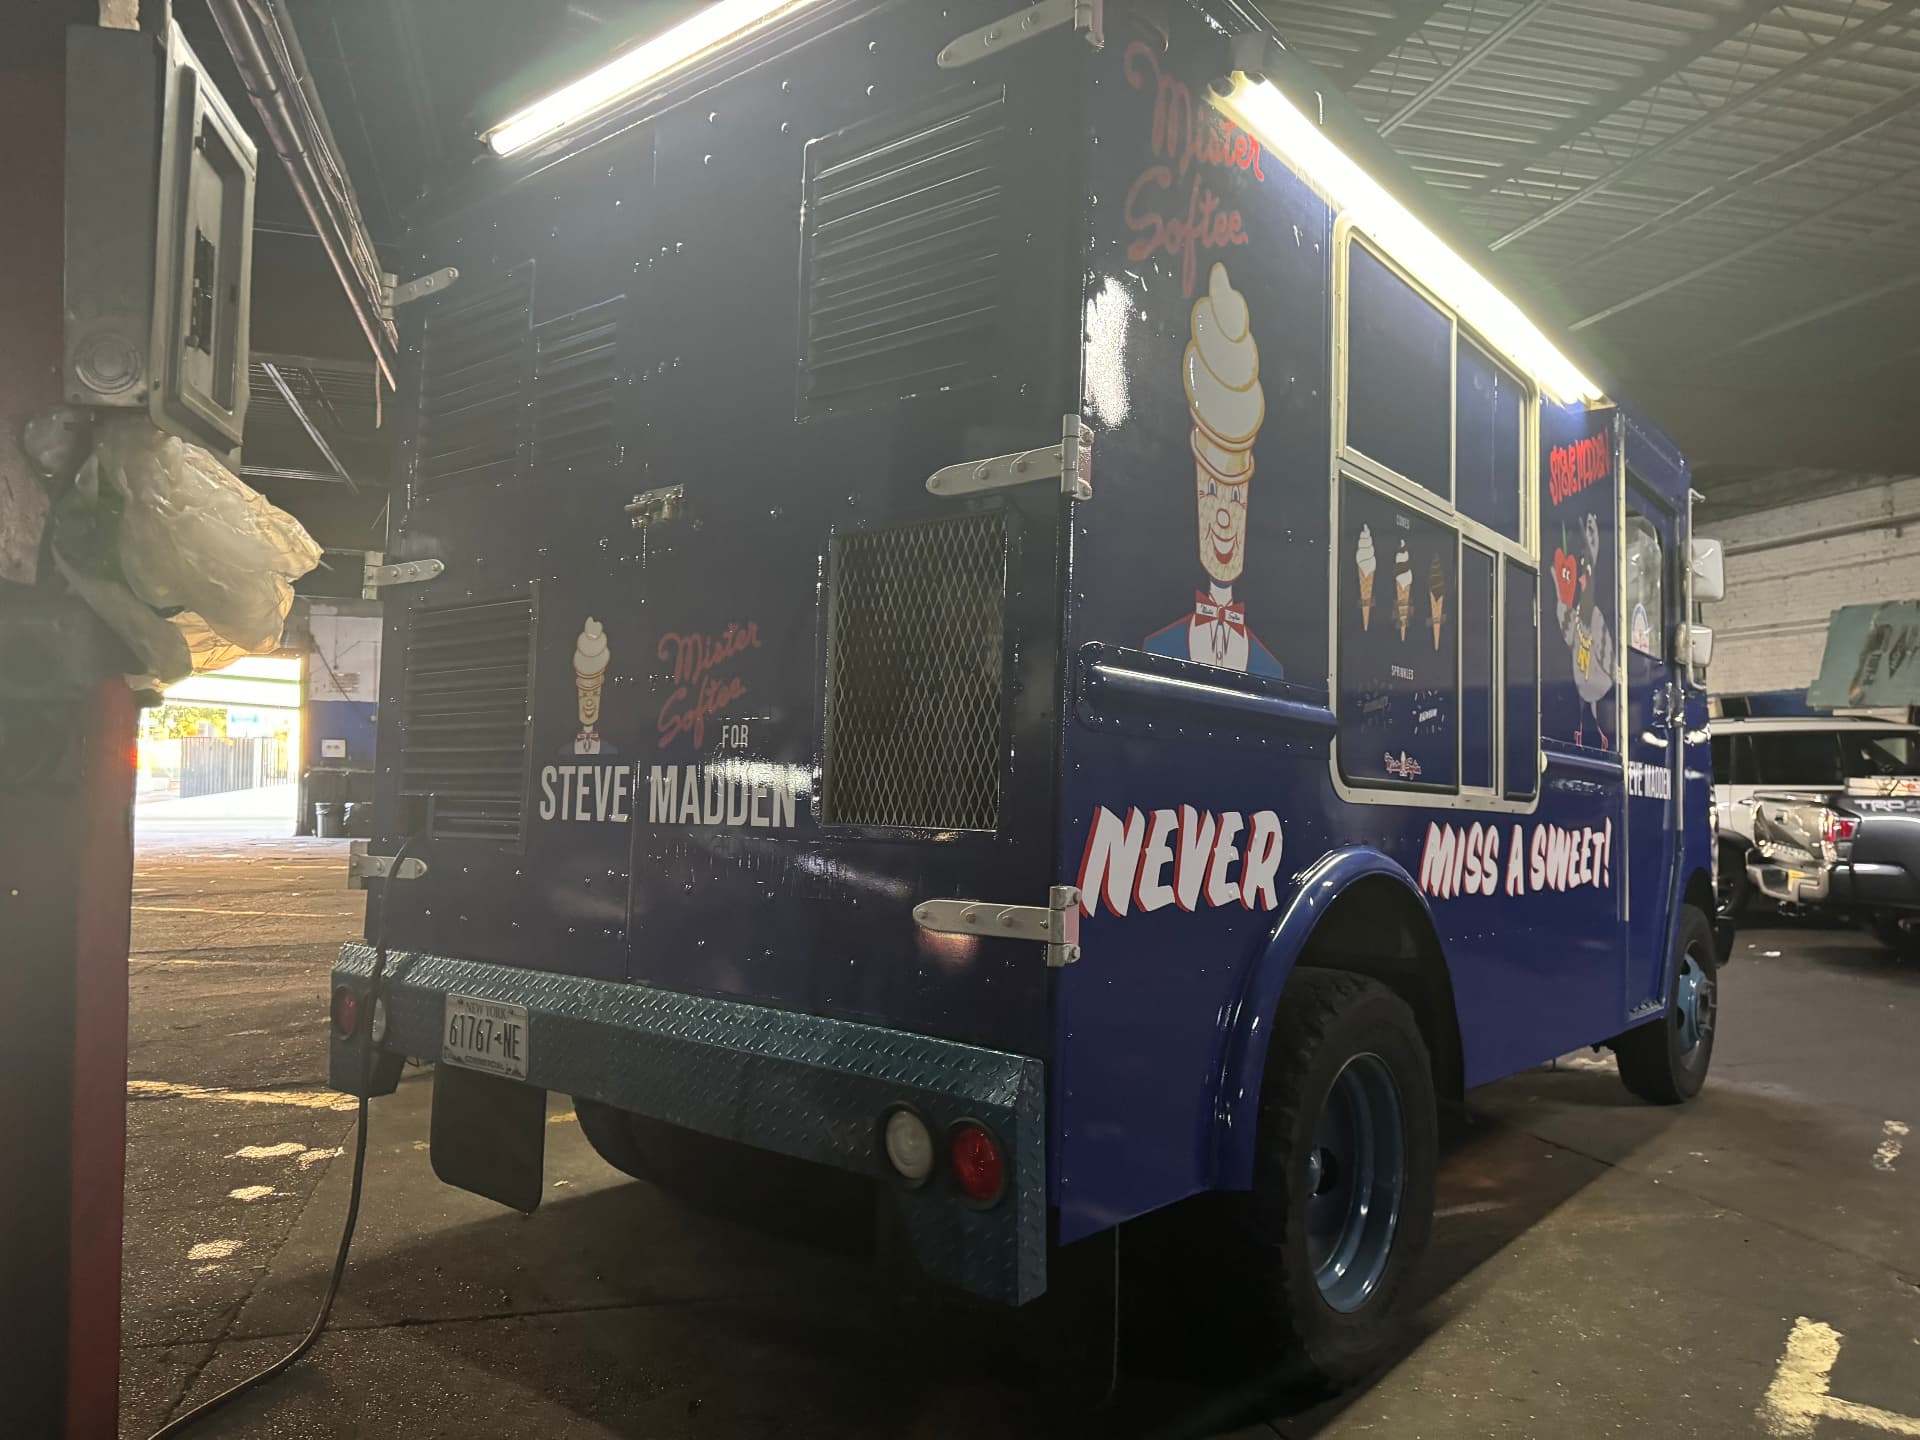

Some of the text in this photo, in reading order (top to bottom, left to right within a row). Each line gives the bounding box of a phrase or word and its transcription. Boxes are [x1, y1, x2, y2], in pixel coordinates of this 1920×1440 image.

[1125, 166, 1249, 298] Softee
[658, 620, 761, 685] Mister
[657, 676, 747, 749] Softee
[722, 724, 749, 749] FOR
[539, 765, 797, 828] STEVE MADDEN
[1628, 761, 1643, 796] EVE
[1854, 800, 1905, 812] TRD
[1076, 803, 1284, 919] NEVER
[1418, 816, 1612, 900] MISS A SWEET!
